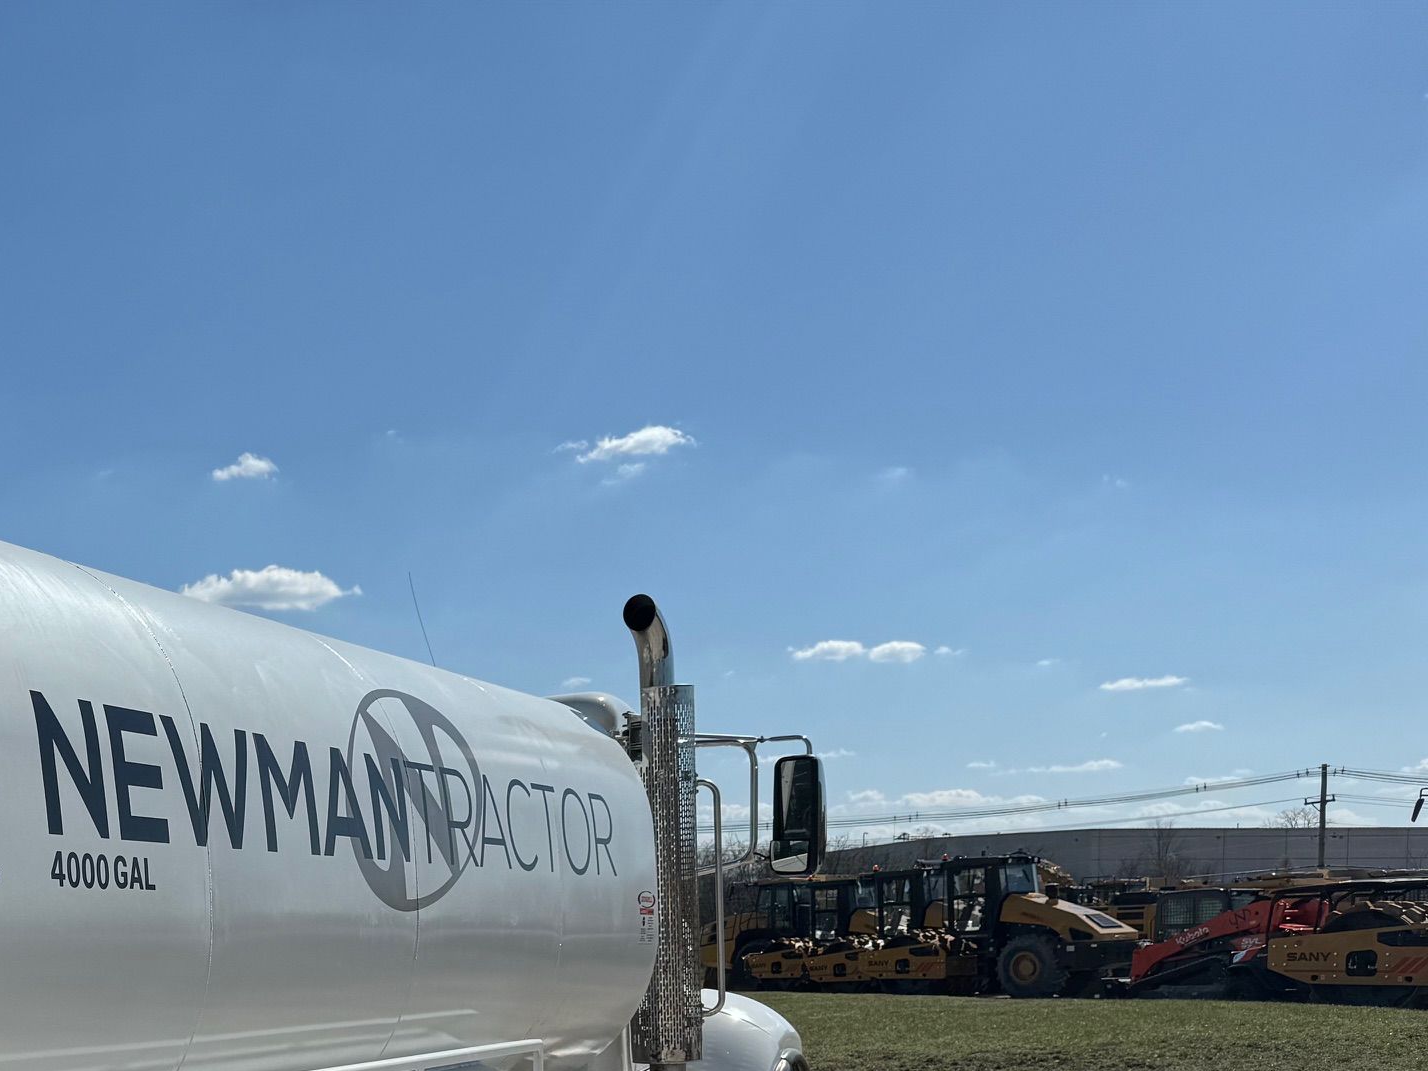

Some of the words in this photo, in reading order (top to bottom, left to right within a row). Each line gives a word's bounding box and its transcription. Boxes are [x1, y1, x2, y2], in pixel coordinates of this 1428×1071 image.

[51, 850, 109, 890] 4000
[114, 855, 156, 891] GAL
[1174, 926, 1210, 946] Kubota
[1286, 952, 1331, 962] SANY
